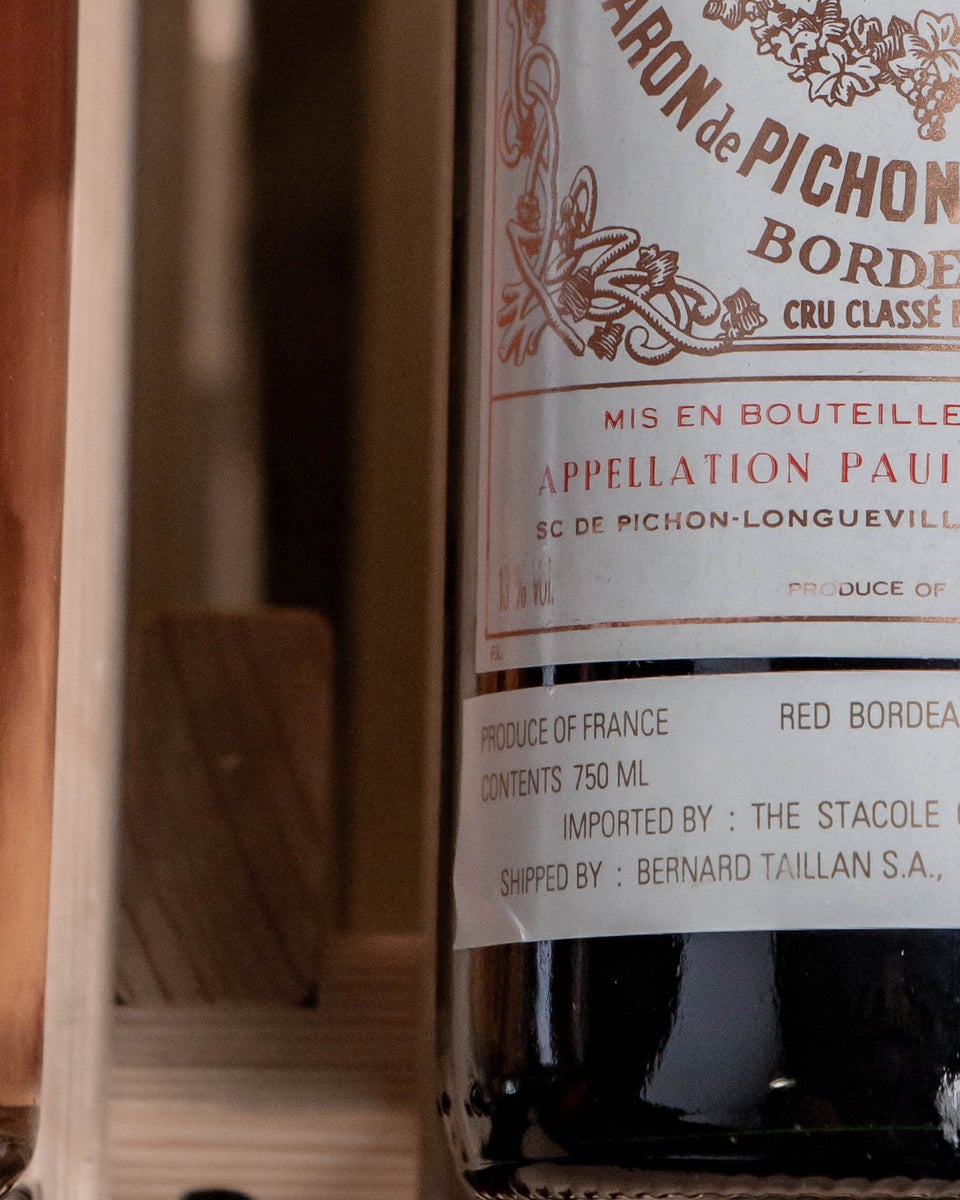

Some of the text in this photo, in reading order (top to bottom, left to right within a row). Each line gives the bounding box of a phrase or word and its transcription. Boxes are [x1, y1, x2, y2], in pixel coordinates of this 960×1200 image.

[695, 103, 742, 163] de
[783, 300, 836, 330] CRU
[846, 295, 942, 329] CLASSÉ
[604, 407, 660, 431] MIS
[677, 405, 722, 428] EN
[538, 452, 811, 497] APPELLATION
[536, 520, 564, 540] SC
[575, 516, 605, 536] DE
[788, 581, 904, 597] PRODUCE
[915, 582, 947, 598] OF
[481, 708, 669, 753] PRODUCE OF FRANCE
[780, 703, 830, 730] RED
[481, 759, 649, 802] CONTENTS 750 ML
[563, 806, 674, 841] IMPORTED
[683, 804, 713, 833] BY
[751, 802, 800, 830] THE
[818, 799, 939, 829] STACOLE
[500, 863, 568, 898] SHIPPED
[576, 860, 602, 889] BY
[637, 853, 751, 886] BERNARD
[761, 850, 871, 882] TAILLAN
